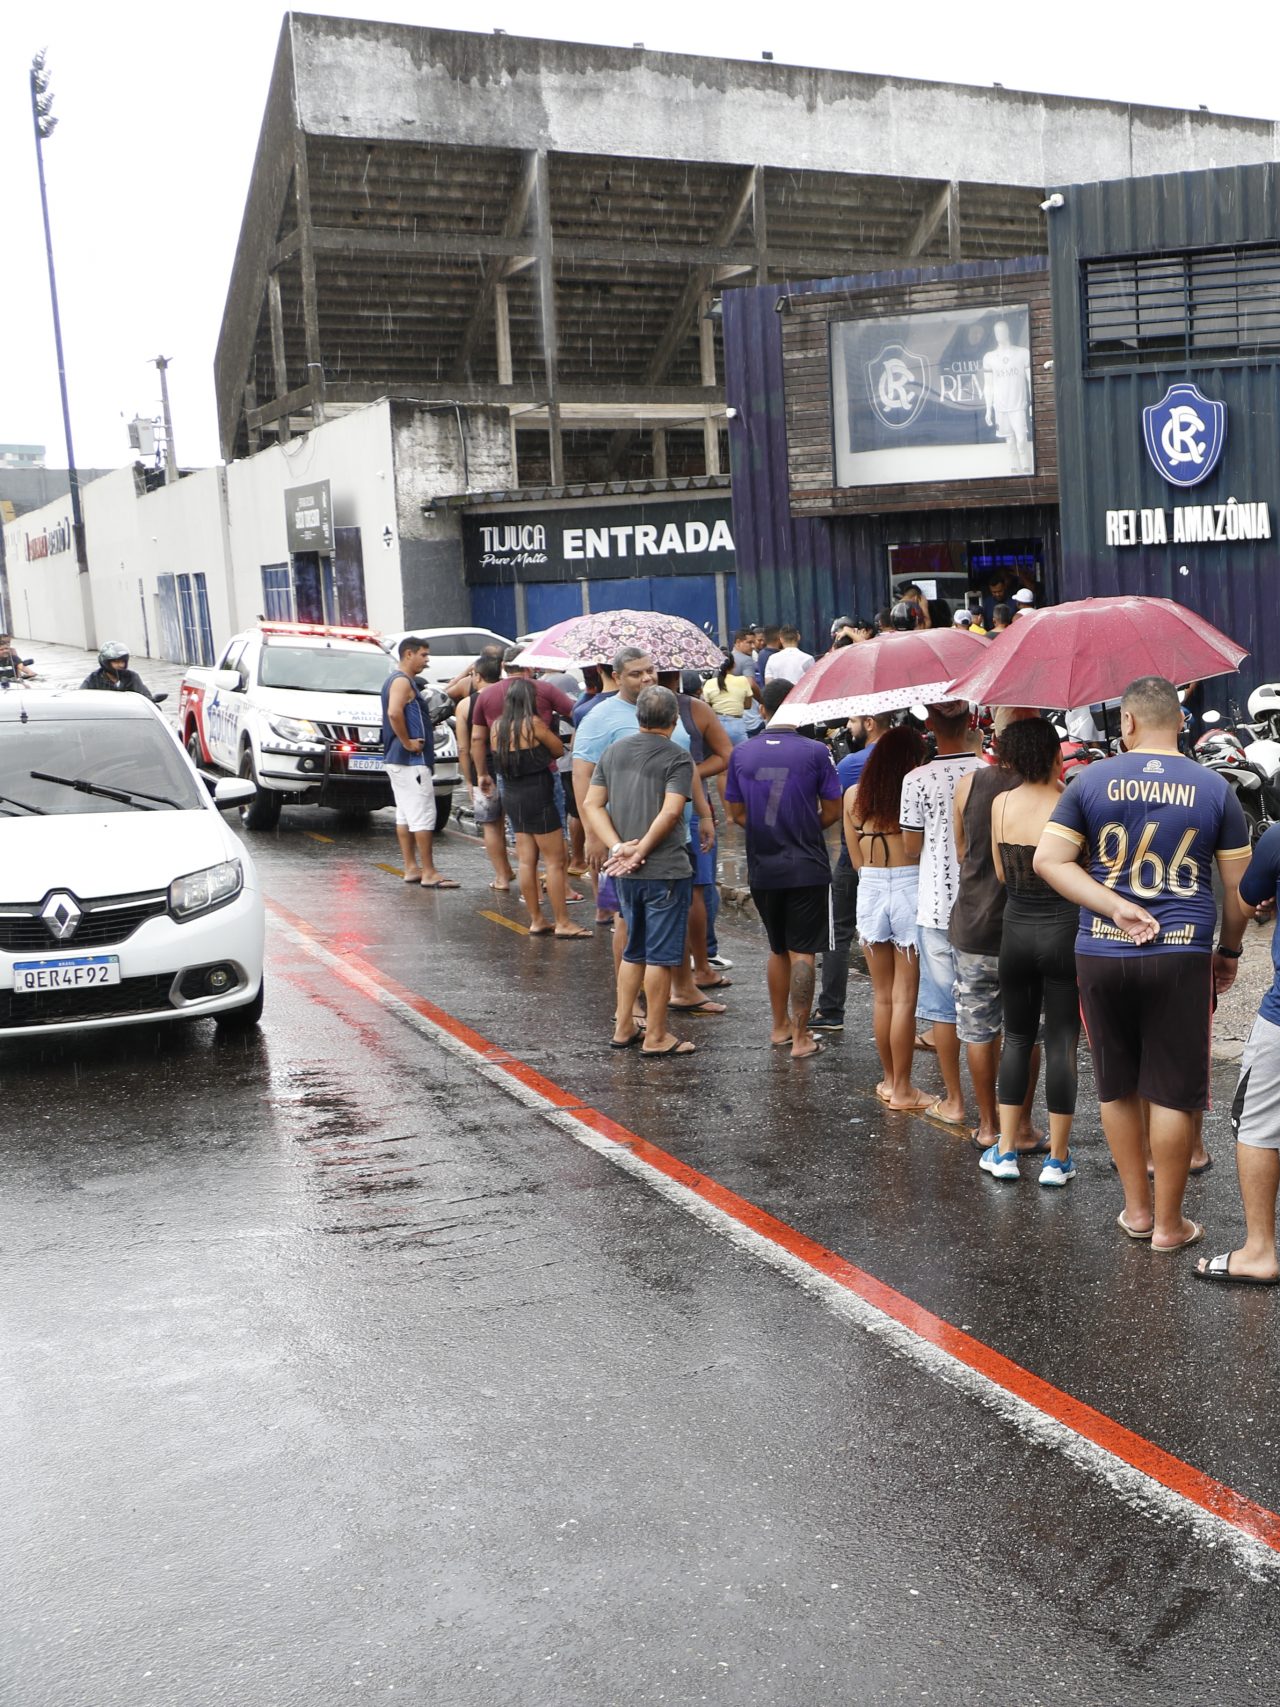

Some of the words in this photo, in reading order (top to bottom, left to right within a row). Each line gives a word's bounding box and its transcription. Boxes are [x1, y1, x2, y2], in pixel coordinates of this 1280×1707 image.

[479, 524, 546, 552] TIJUCA
[563, 519, 736, 560] ENTRADA
[1106, 509, 1137, 546] REI
[1141, 508, 1168, 545] DA
[1173, 496, 1271, 543] AMAZÔNIA
[754, 767, 790, 827] 7
[1107, 779, 1196, 807] GIOVANNI
[1099, 821, 1200, 899] 966
[24, 966, 109, 989] QER4F92
